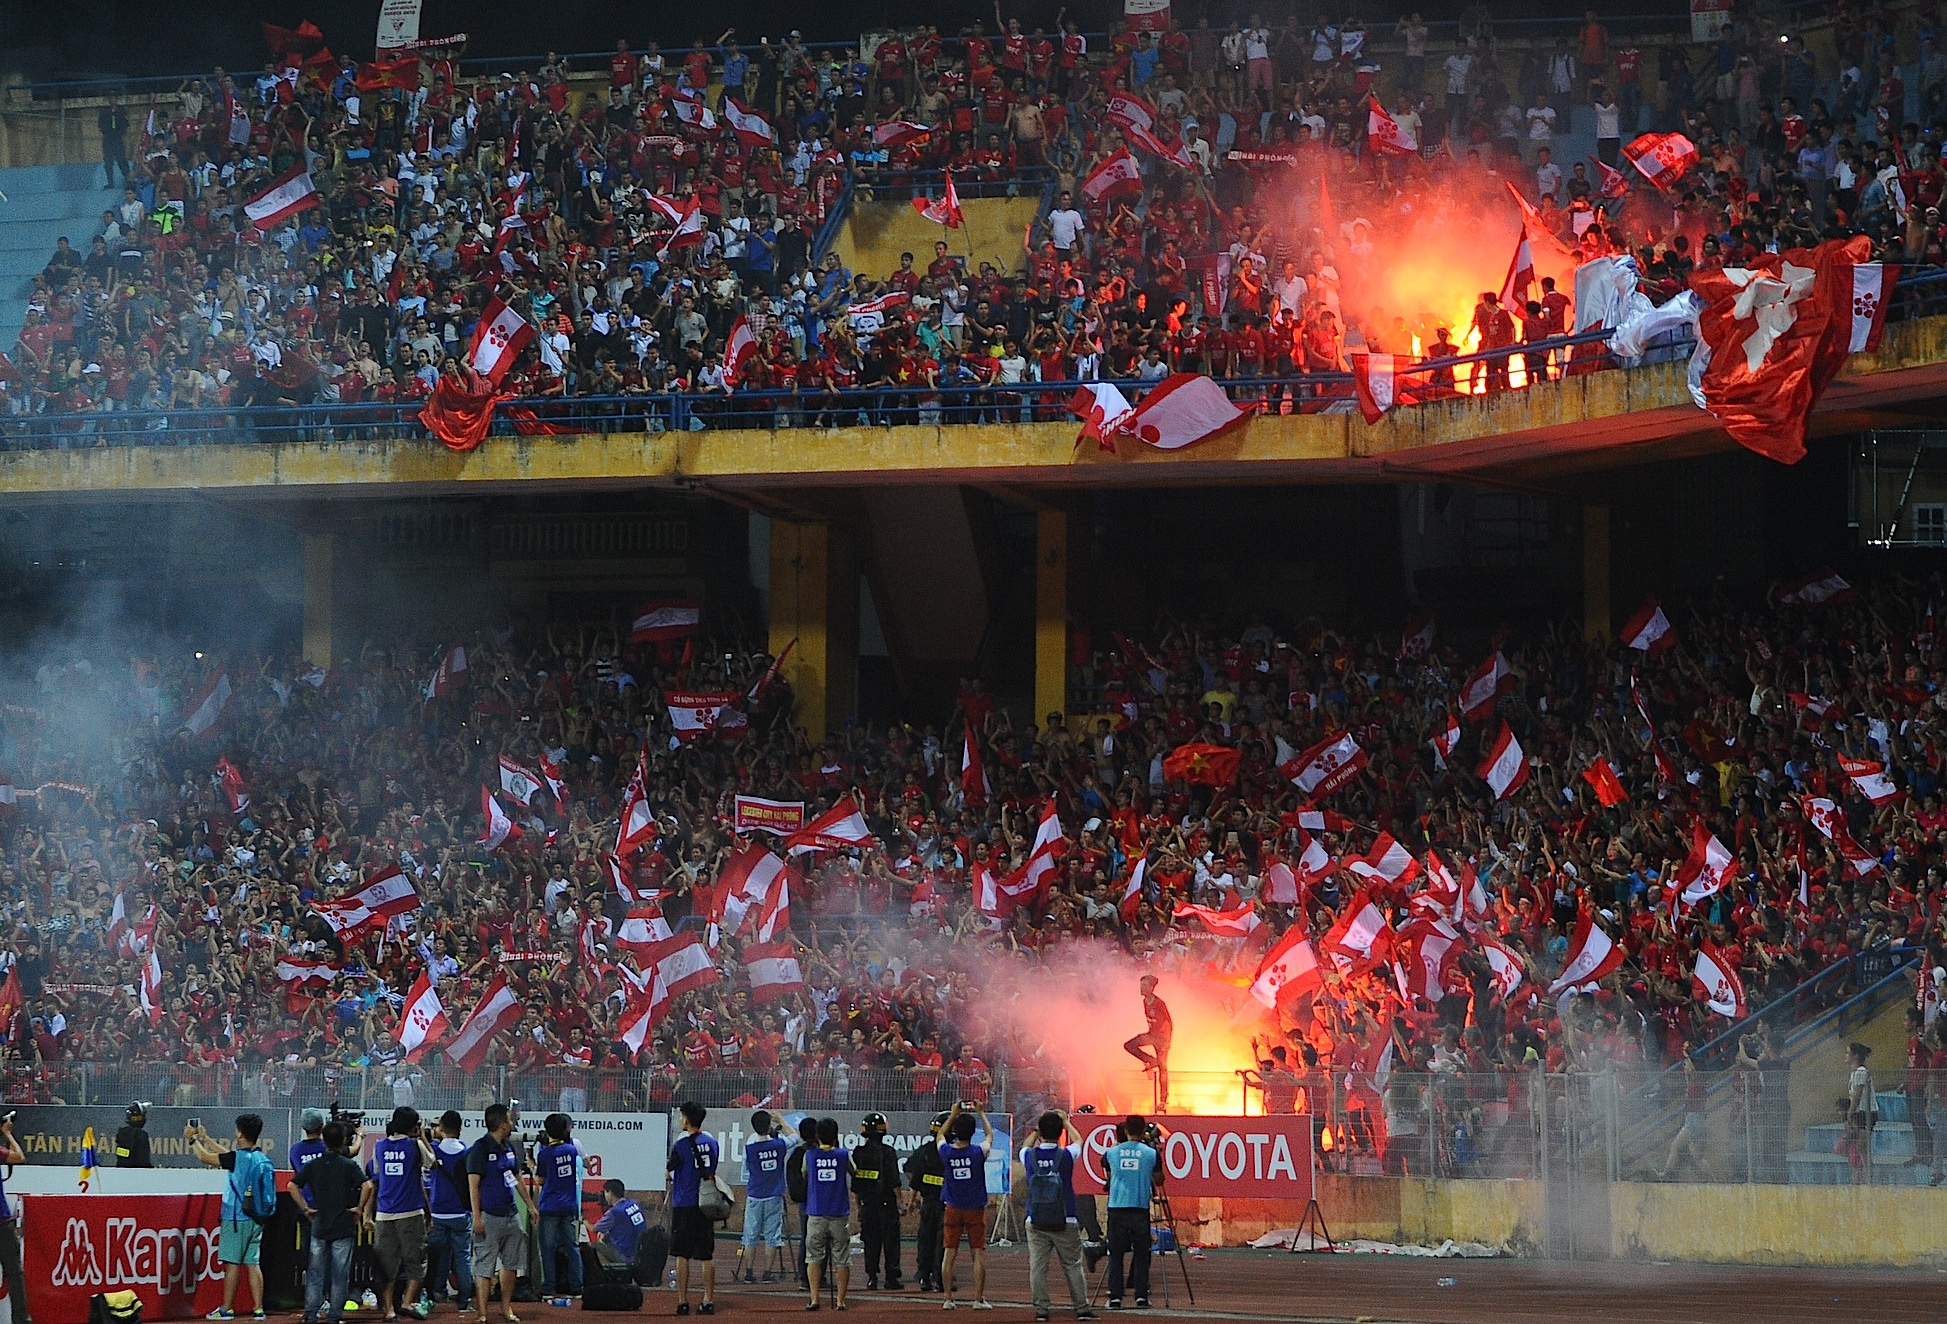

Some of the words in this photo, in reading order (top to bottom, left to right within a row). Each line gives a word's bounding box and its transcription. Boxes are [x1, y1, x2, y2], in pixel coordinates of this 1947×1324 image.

[23, 1131, 63, 1153] TÂN
[384, 1150, 406, 1161] 2016
[758, 1149, 778, 1159] 2016
[1165, 1131, 1297, 1181] OYOTA
[555, 1154, 572, 1165] 2016
[816, 1158, 838, 1167] 2016
[949, 1157, 971, 1167] 2016
[1037, 1159, 1054, 1168] 201
[924, 1175, 942, 1184] CSC
